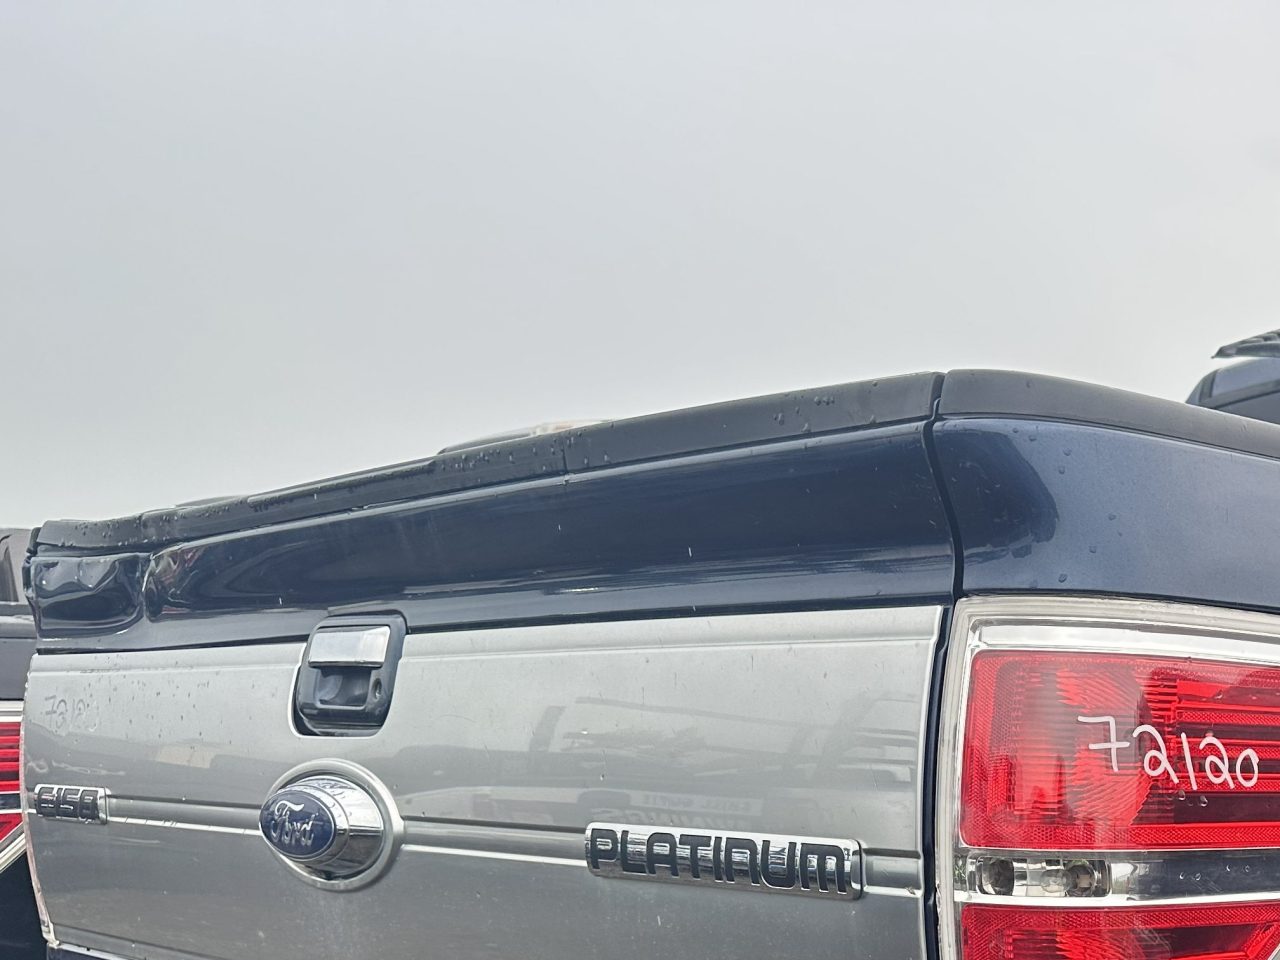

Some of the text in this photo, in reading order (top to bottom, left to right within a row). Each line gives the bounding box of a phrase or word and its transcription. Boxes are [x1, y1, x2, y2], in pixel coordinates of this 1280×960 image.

[1077, 715, 1260, 790] 72120
[270, 800, 320, 847] Ford
[588, 827, 849, 895] PLATINUM
